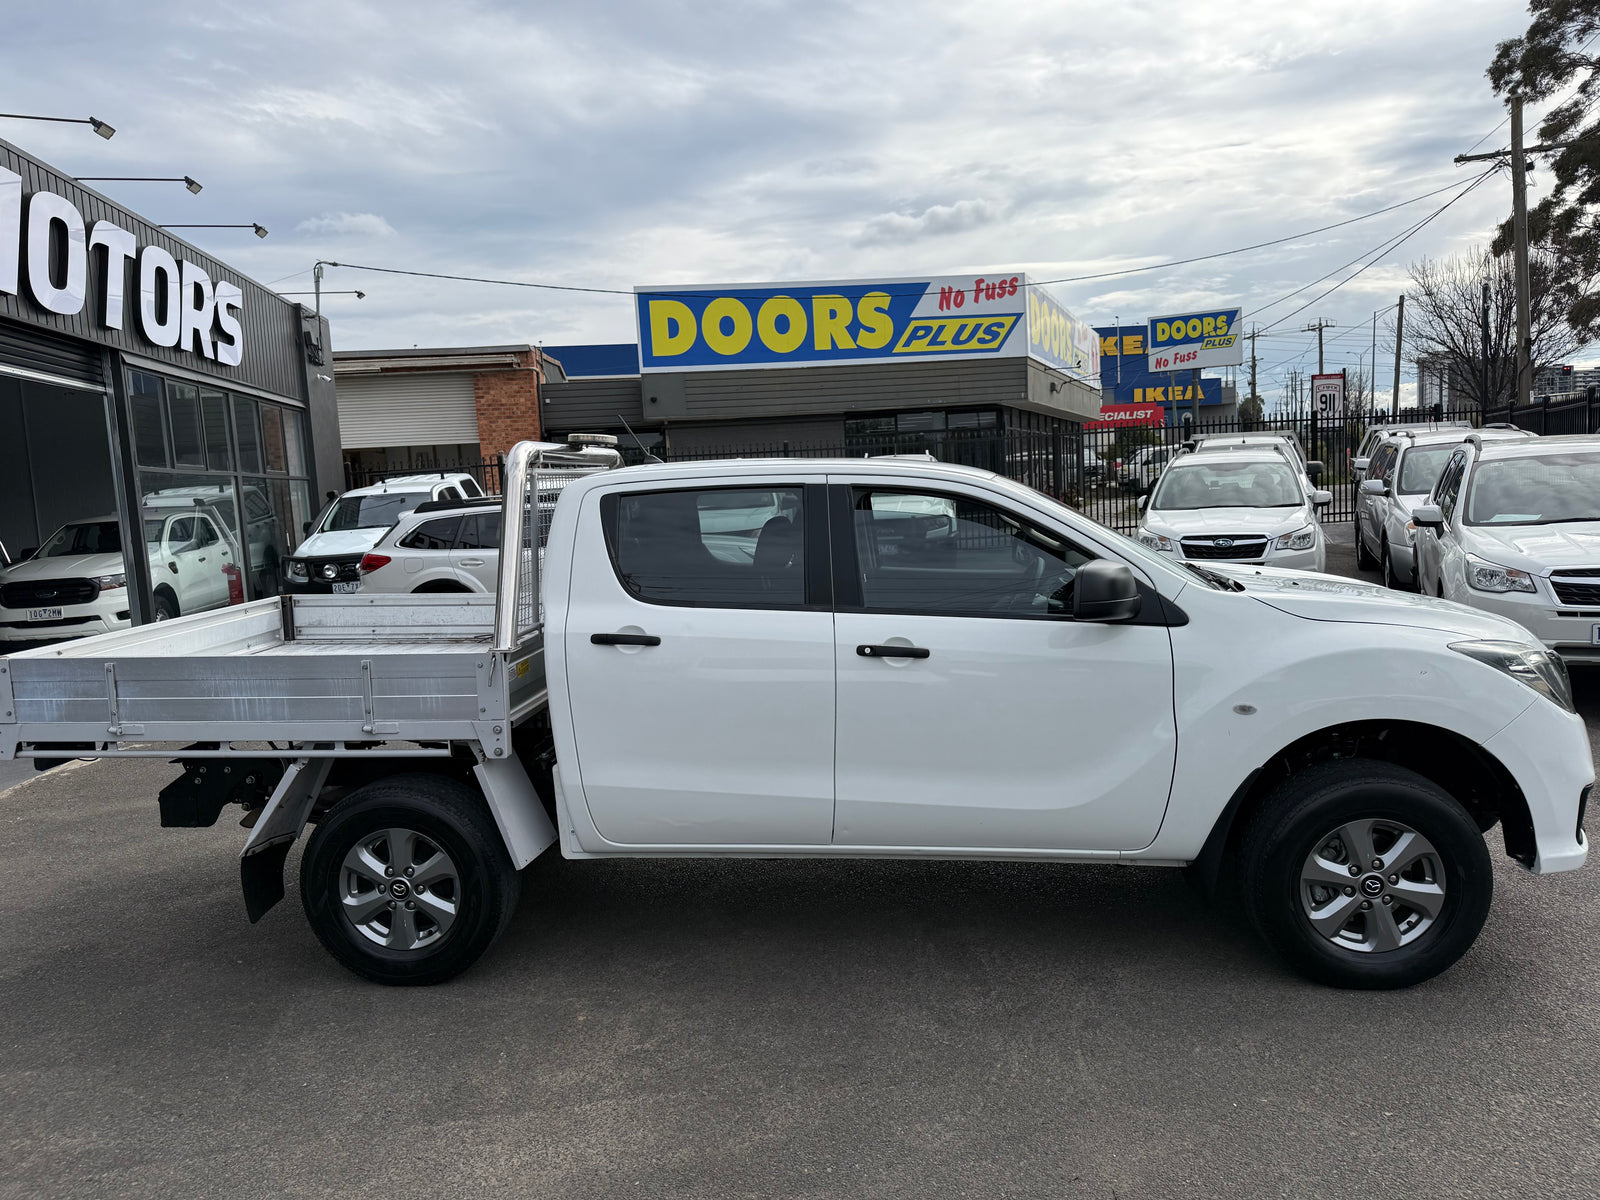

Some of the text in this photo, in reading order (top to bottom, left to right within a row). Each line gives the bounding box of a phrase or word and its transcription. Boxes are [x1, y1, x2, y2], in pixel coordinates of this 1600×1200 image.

[939, 277, 1018, 311] No Fuss
[649, 291, 894, 357] DOORS
[902, 322, 1005, 348] PLUS
[1030, 291, 1072, 365] DOORS
[1156, 315, 1228, 342] DOORS
[1099, 335, 1148, 357] KE
[1204, 336, 1233, 348] PLUS
[1155, 350, 1198, 369] No Fuss
[1134, 385, 1205, 403] IKEA
[1320, 394, 1335, 411] 911
